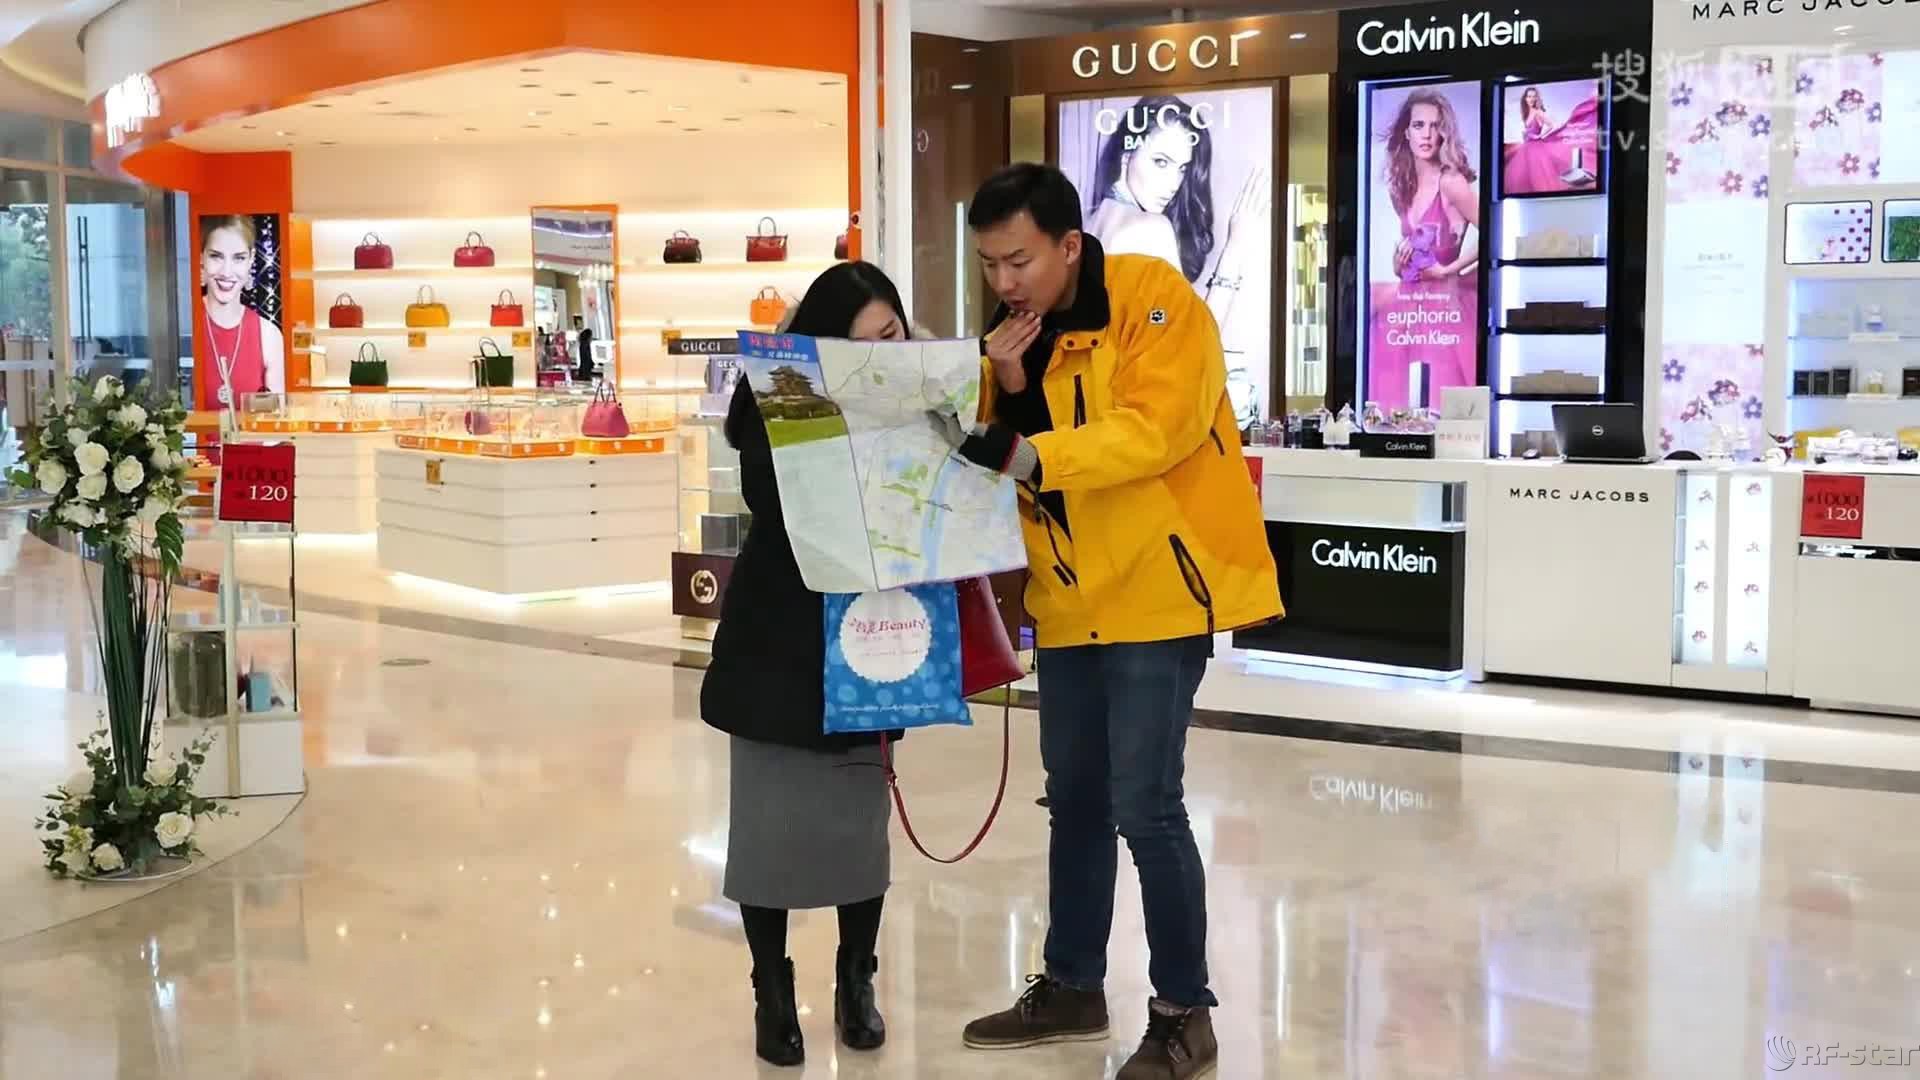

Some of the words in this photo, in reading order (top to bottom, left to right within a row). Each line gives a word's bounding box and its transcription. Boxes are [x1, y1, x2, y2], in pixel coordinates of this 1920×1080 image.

[1692, 0, 1784, 20] MARC
[1356, 16, 1455, 56] Calvin
[1461, 9, 1540, 48] Klein
[1072, 33, 1240, 78] GUCCI
[1095, 101, 1232, 135] GUCCI
[1386, 304, 1461, 329] euphoria
[680, 341, 721, 352] GUCCI
[1386, 329, 1427, 346] Calvin
[1428, 329, 1460, 345] Klein
[249, 485, 288, 501] 120
[1509, 488, 1561, 500] MARC
[1569, 490, 1649, 503] JACOBS
[1826, 507, 1860, 521] 120
[1311, 539, 1380, 569] Calvin
[1383, 543, 1437, 574] Klein
[879, 618, 926, 632] Beauty
